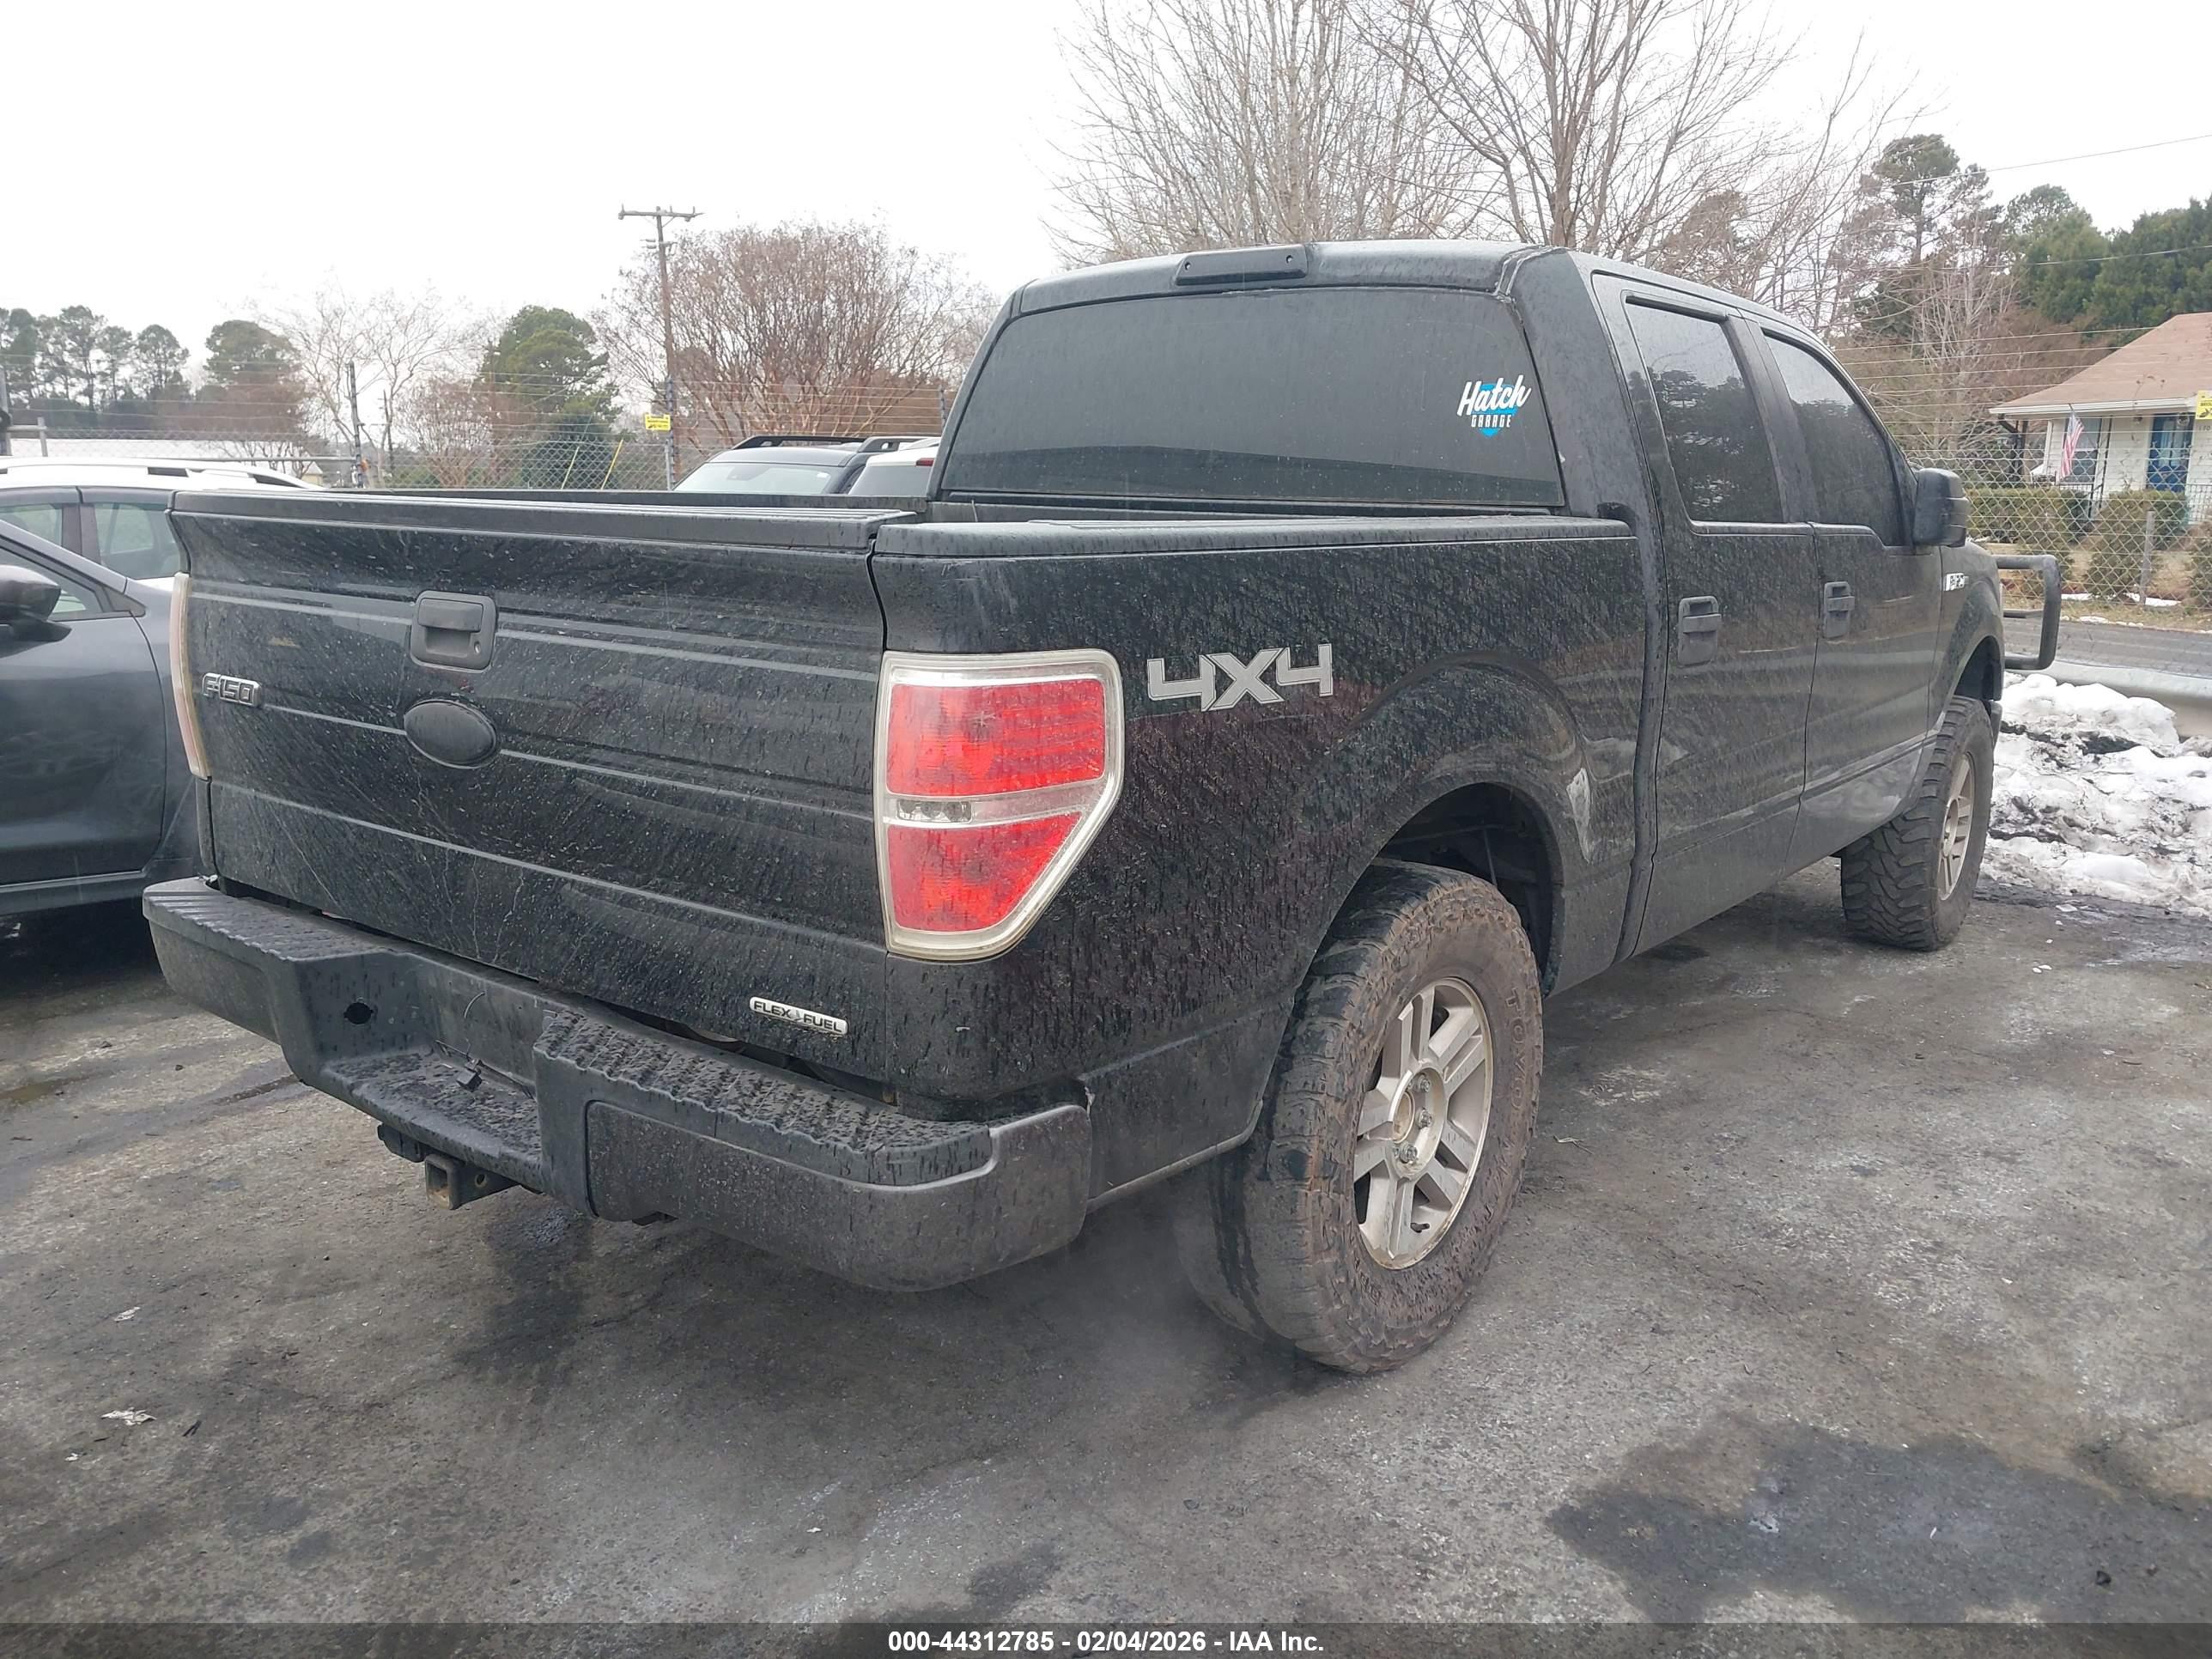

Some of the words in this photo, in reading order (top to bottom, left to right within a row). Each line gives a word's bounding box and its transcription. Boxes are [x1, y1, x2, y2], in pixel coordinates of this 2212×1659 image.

[1456, 374, 1532, 416] Hatch
[1471, 414, 1511, 428] GARAGE
[1146, 643, 1334, 712] 4X4
[753, 1000, 791, 1018] FLEX
[803, 1013, 842, 1033] FUEL
